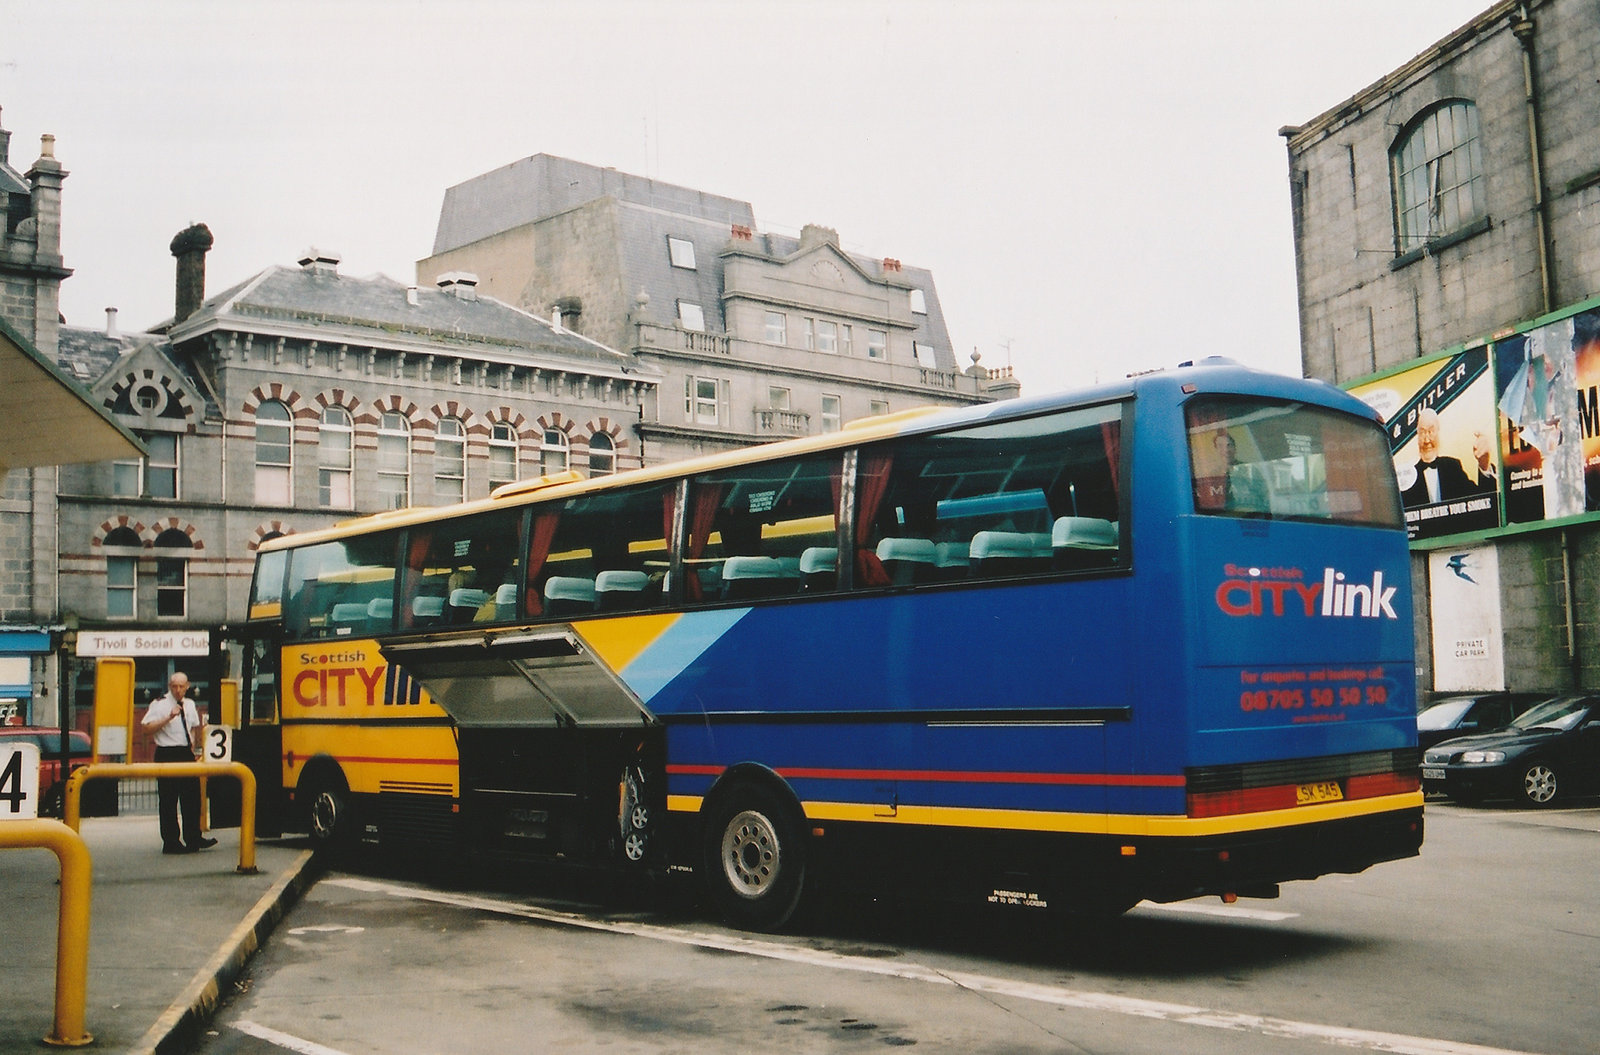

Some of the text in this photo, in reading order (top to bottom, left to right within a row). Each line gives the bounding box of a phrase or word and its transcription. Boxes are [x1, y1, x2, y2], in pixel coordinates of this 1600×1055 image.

[1407, 363, 1466, 426] BUTLER
[1449, 502, 1467, 515] YOUR
[1467, 498, 1491, 512] SMOKE
[1223, 564, 1303, 579] Scottish
[94, 637, 209, 649] Tivoli Social Club
[1456, 640, 1483, 648] PRIVATE
[300, 650, 366, 665] Scottish
[1308, 670, 1325, 681] and
[1240, 685, 1387, 711] 08705 50 50 50
[210, 729, 227, 760] 3
[0, 751, 27, 813] 4
[1318, 783, 1338, 799] 545
[987, 895, 998, 903] NOT
[993, 889, 1027, 899] PASSENGERS
